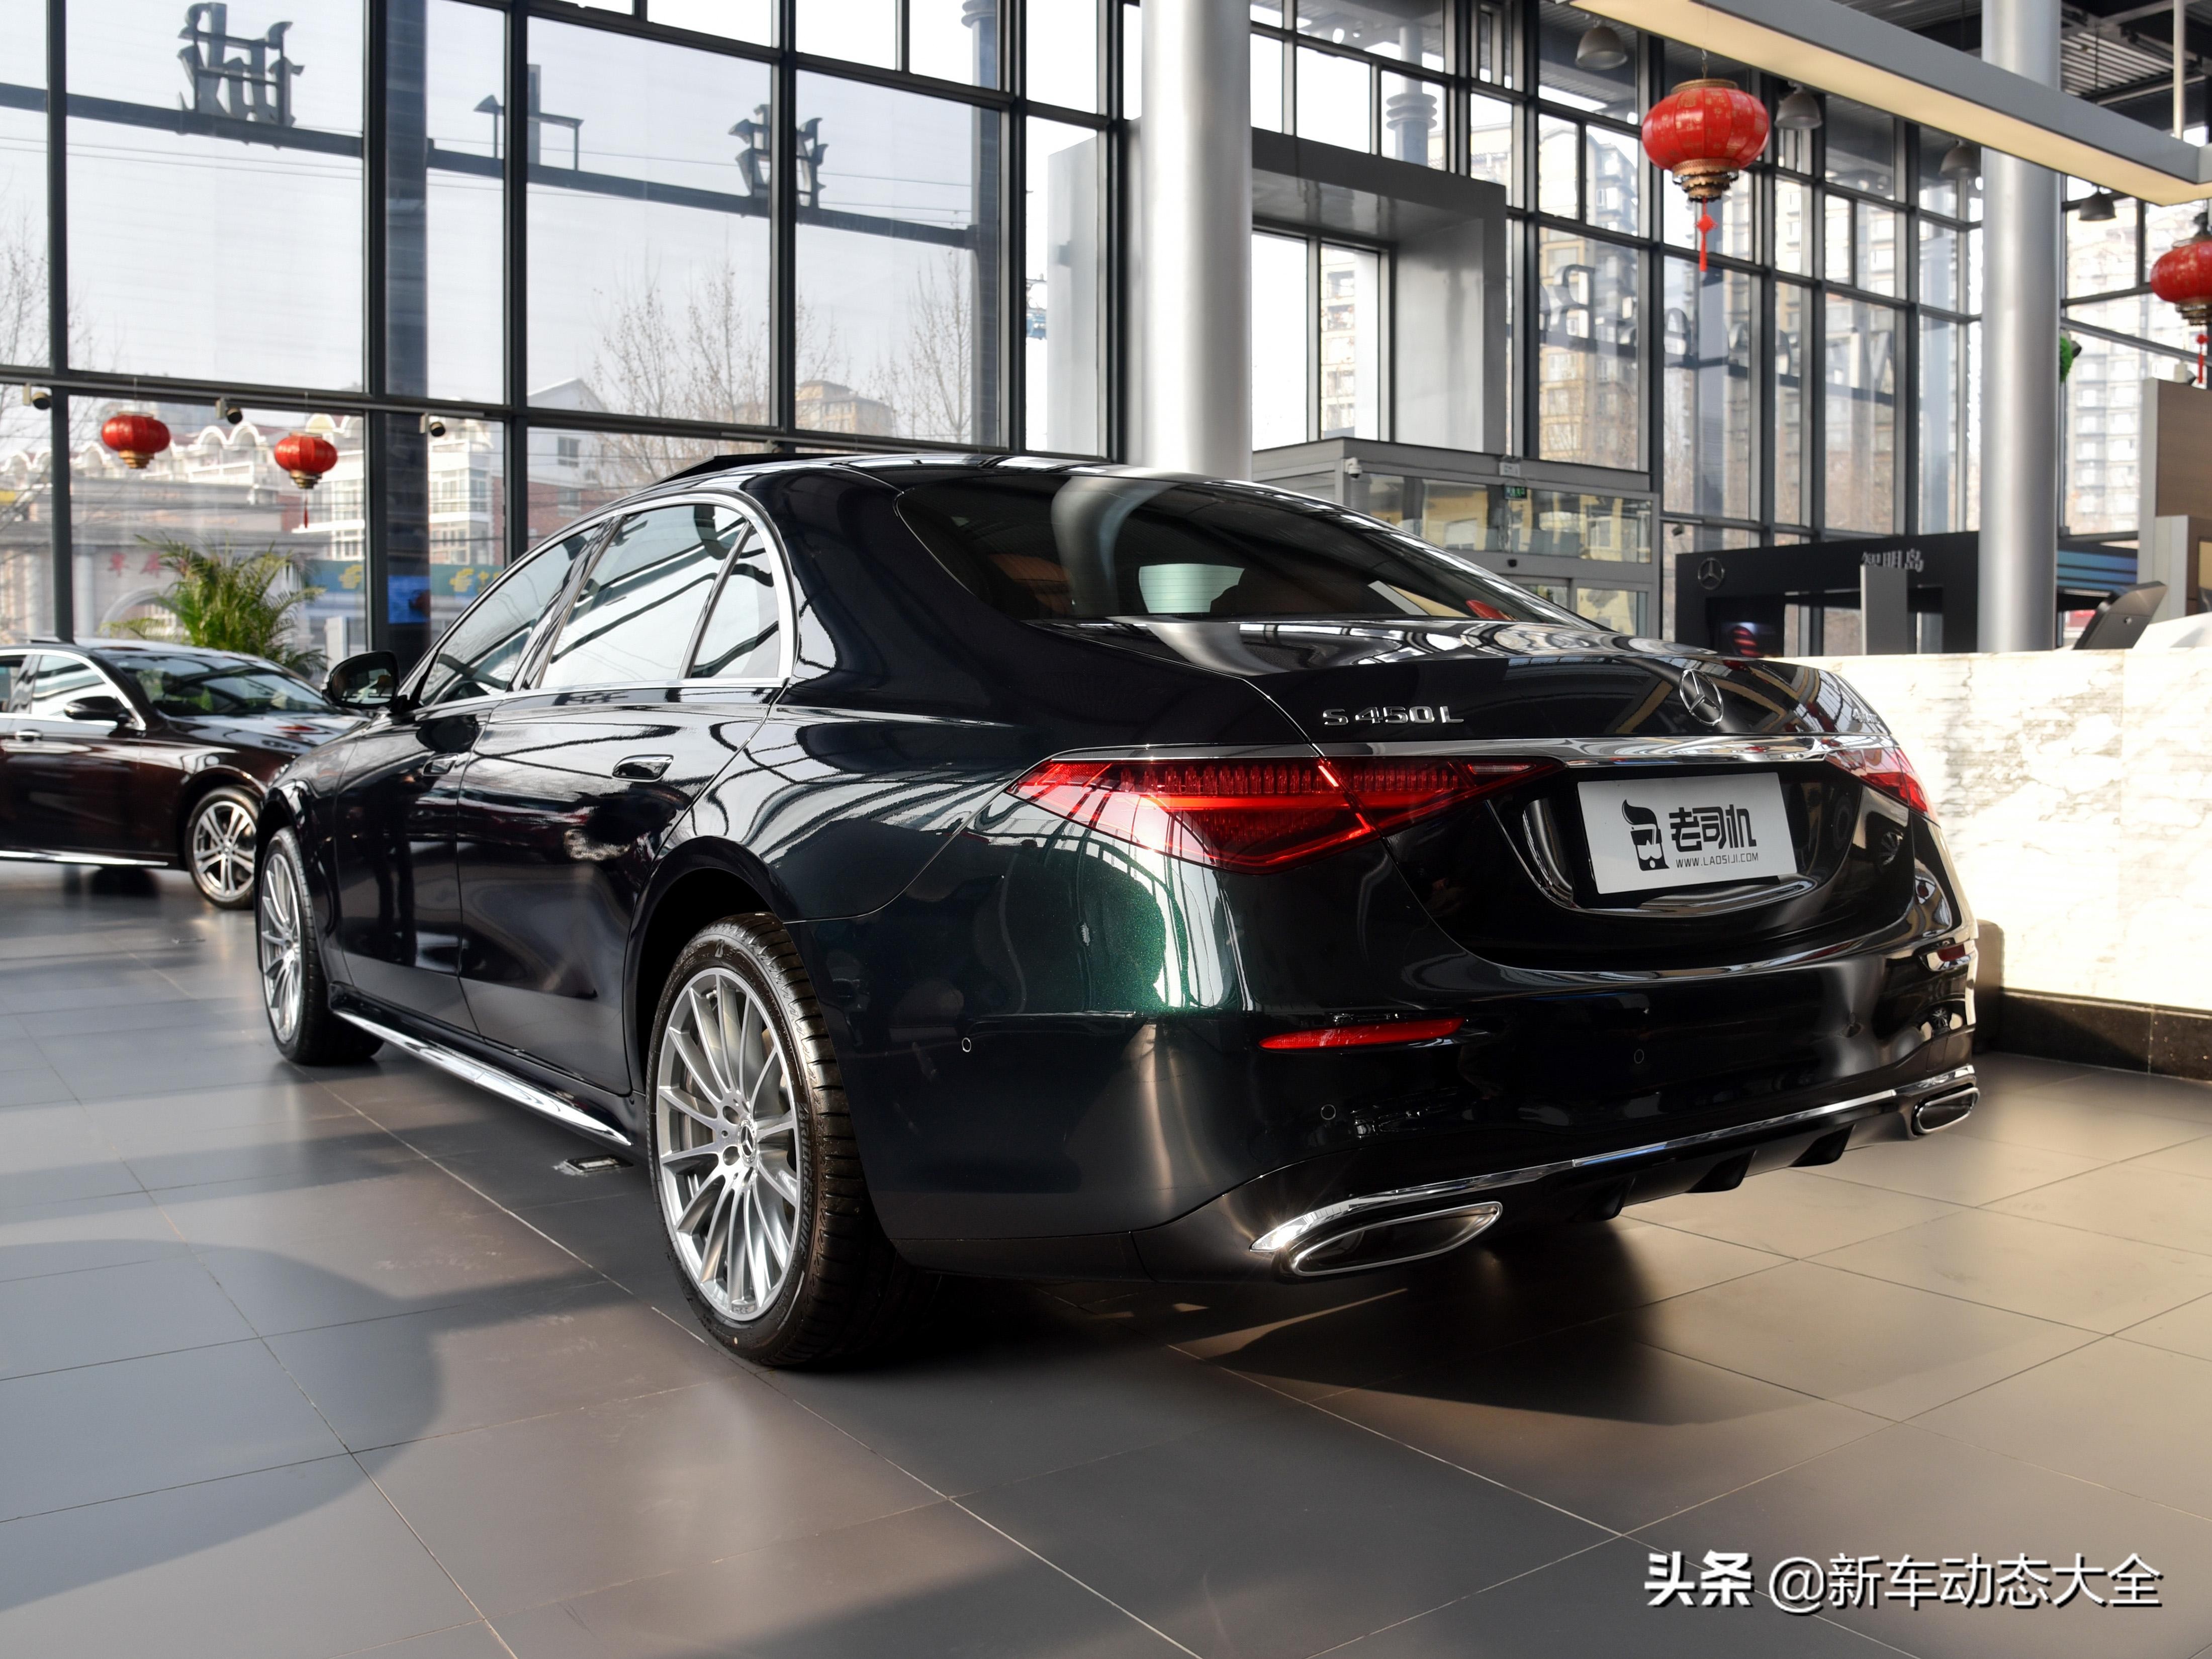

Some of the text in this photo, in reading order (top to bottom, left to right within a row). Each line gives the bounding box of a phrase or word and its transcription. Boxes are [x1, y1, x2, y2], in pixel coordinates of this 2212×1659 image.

[1669, 804, 1757, 853] 老司机
[1676, 852, 1759, 868] WWW.LAOSIJI.COM
[797, 1101, 813, 1259] BRIDGESTONE
